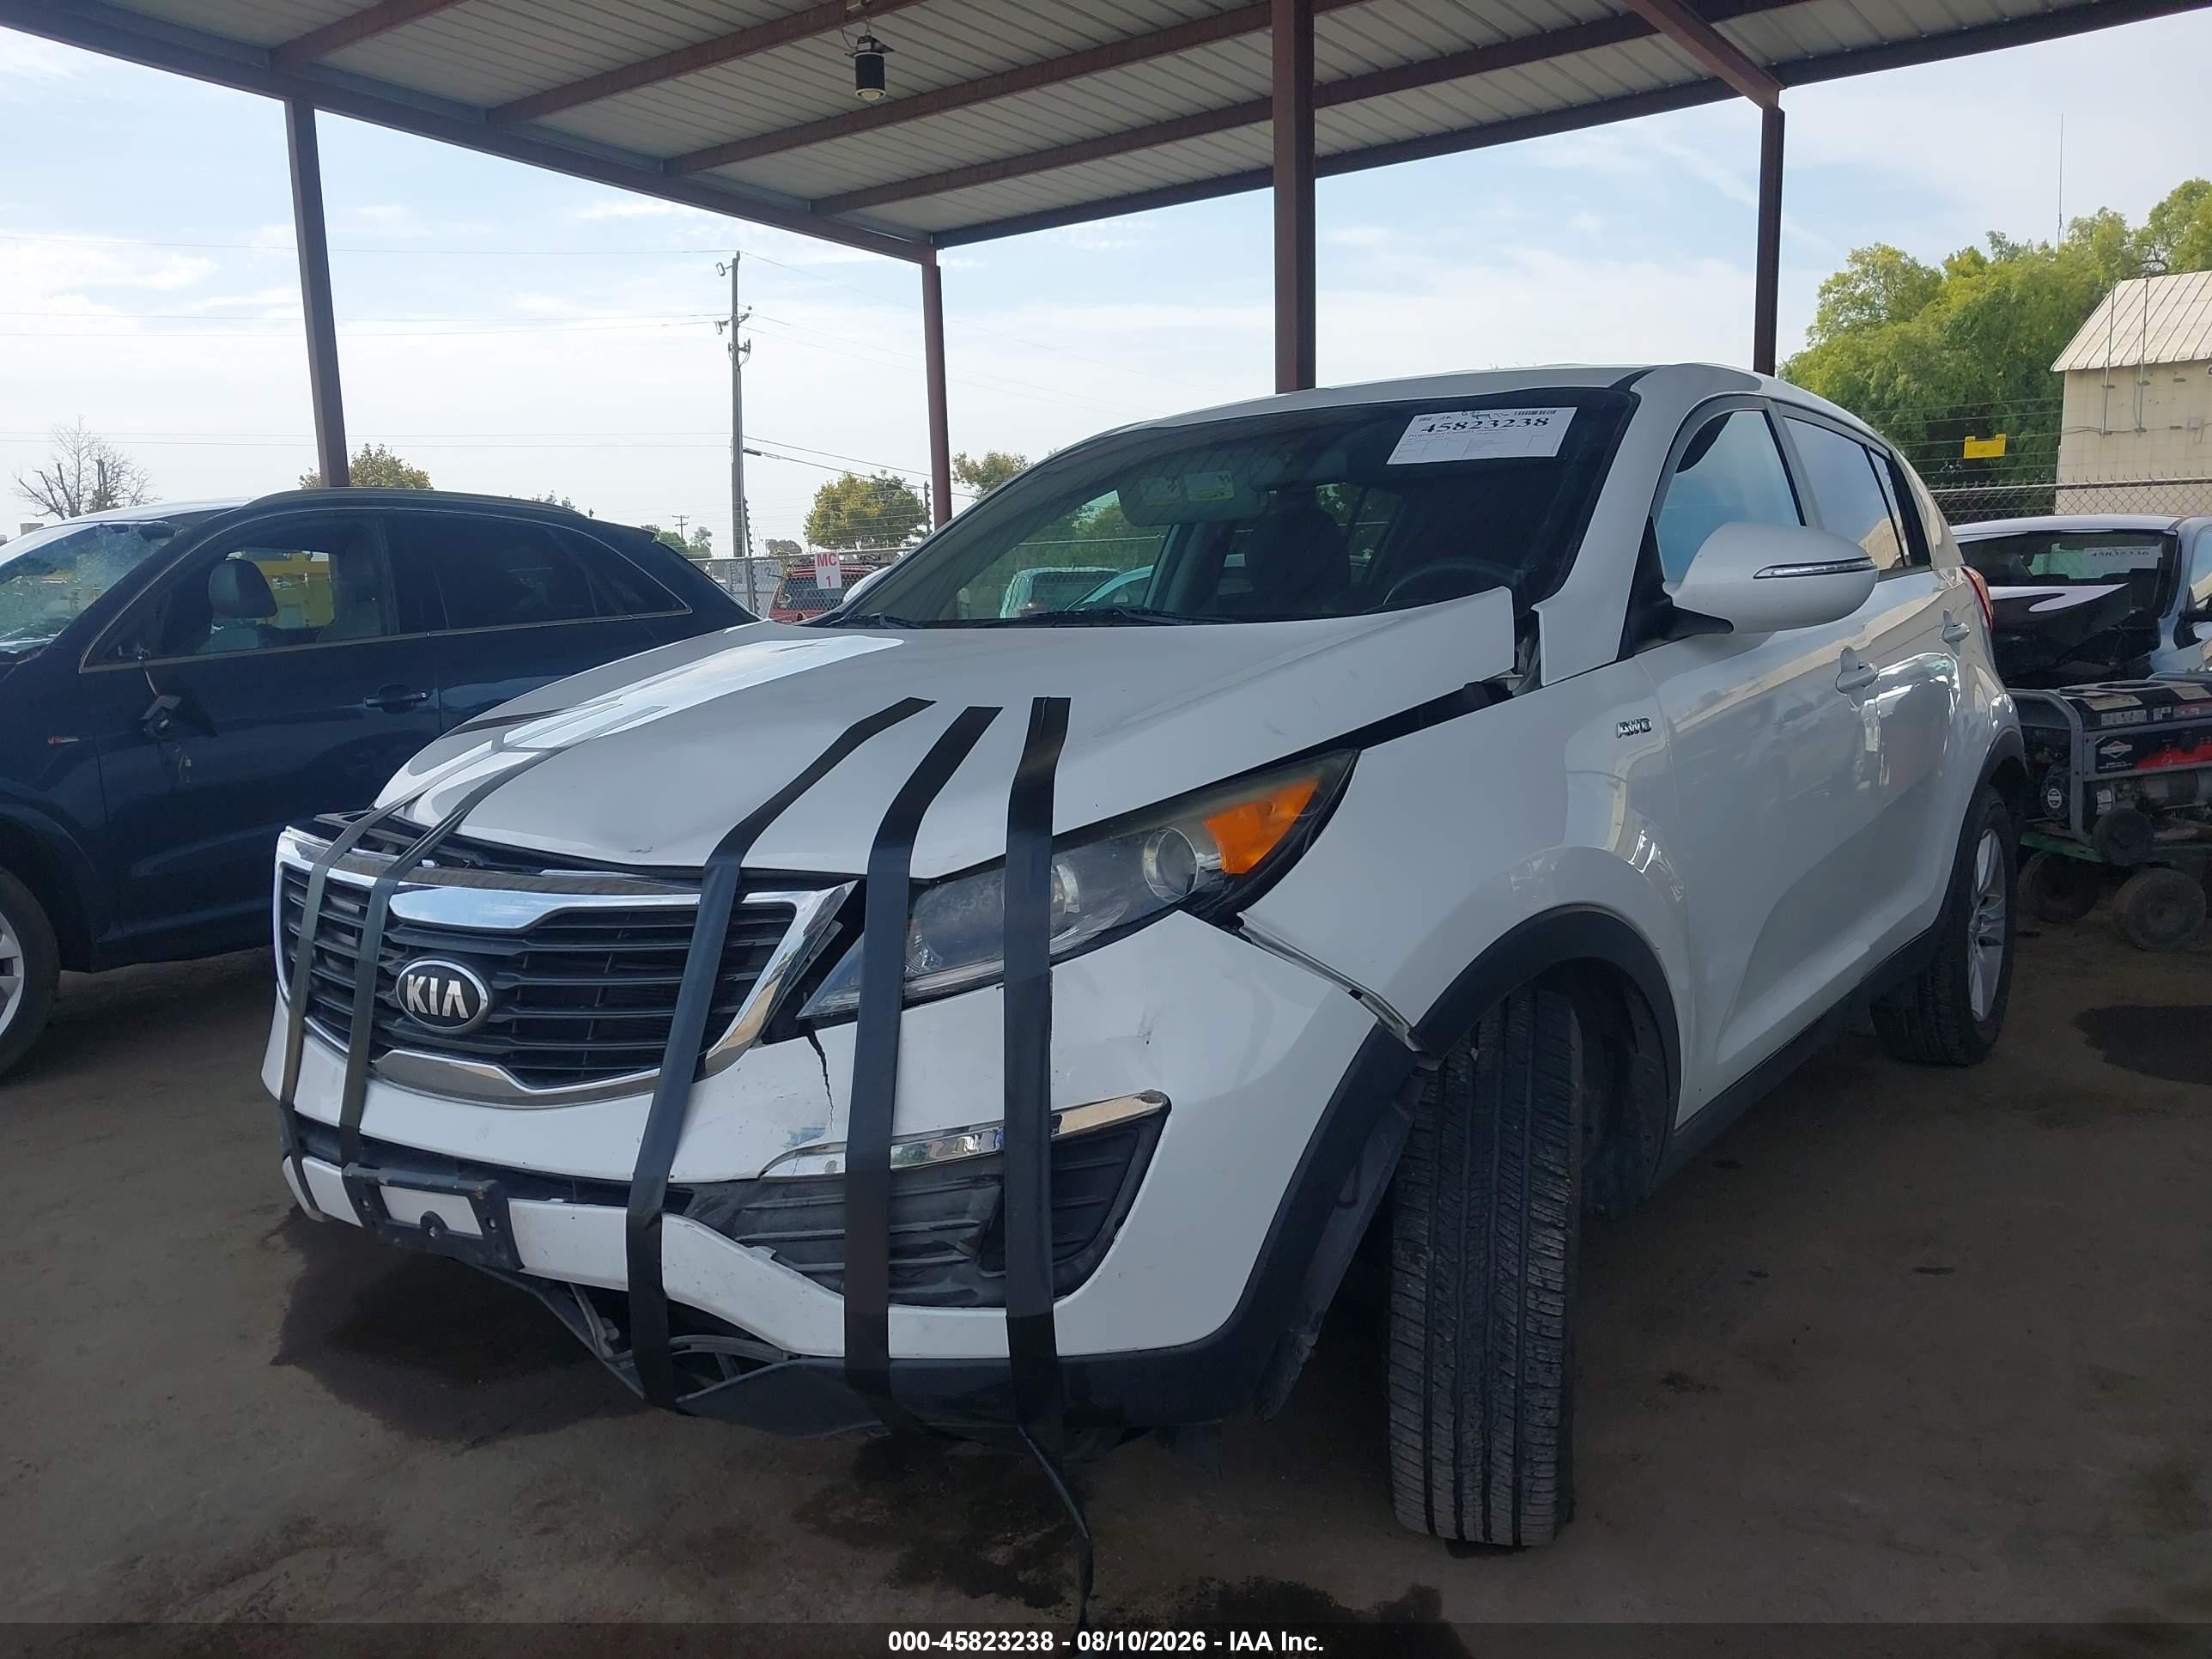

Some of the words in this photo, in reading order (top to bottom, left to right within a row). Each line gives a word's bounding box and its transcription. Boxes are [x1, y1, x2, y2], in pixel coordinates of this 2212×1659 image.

[1421, 417, 1549, 433] 45823238
[817, 553, 837, 567] MC
[825, 575, 832, 587] 1
[1616, 717, 1652, 738] AWD
[406, 974, 470, 1019] KIA
